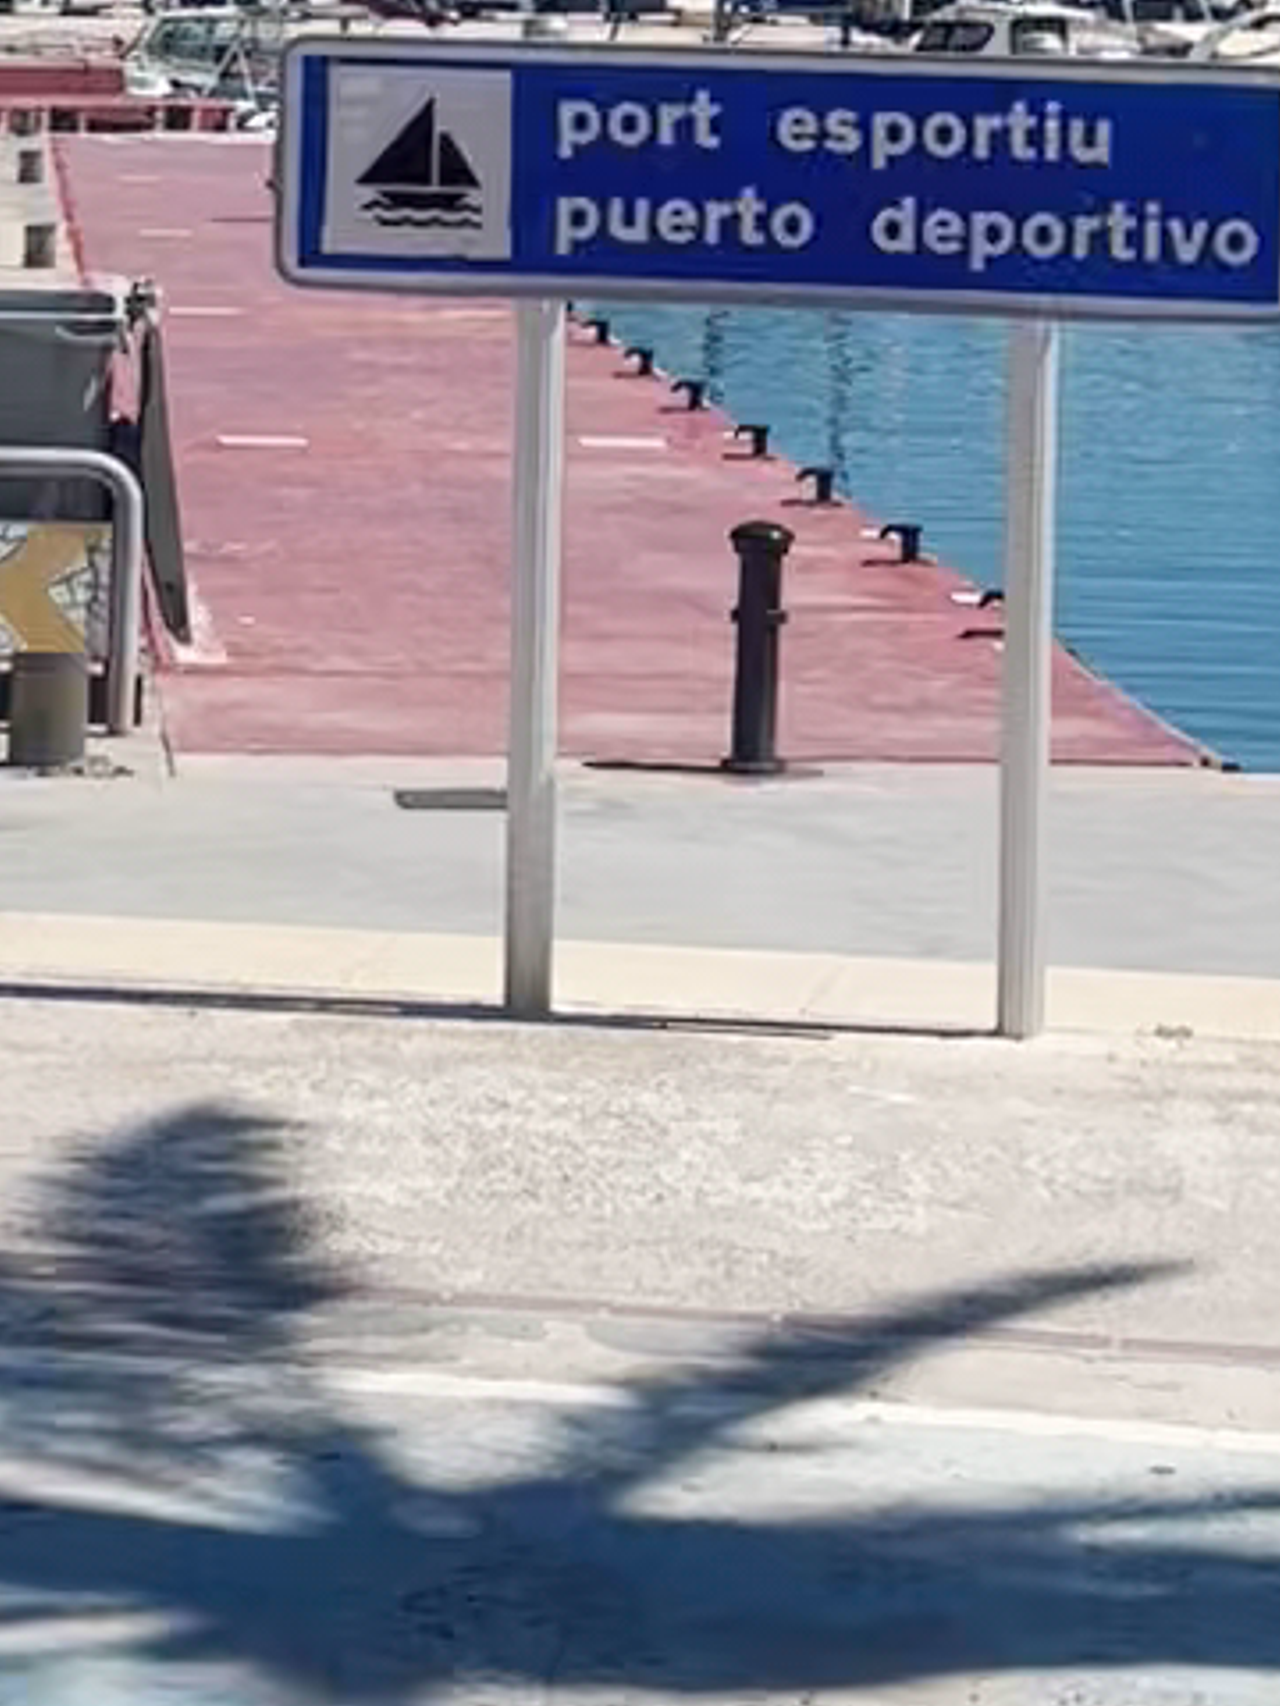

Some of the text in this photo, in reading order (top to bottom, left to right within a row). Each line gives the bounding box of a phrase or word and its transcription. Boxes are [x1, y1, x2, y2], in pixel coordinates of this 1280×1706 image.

[558, 89, 1111, 169] port esportiu
[556, 187, 1259, 271] puerto deportivo
